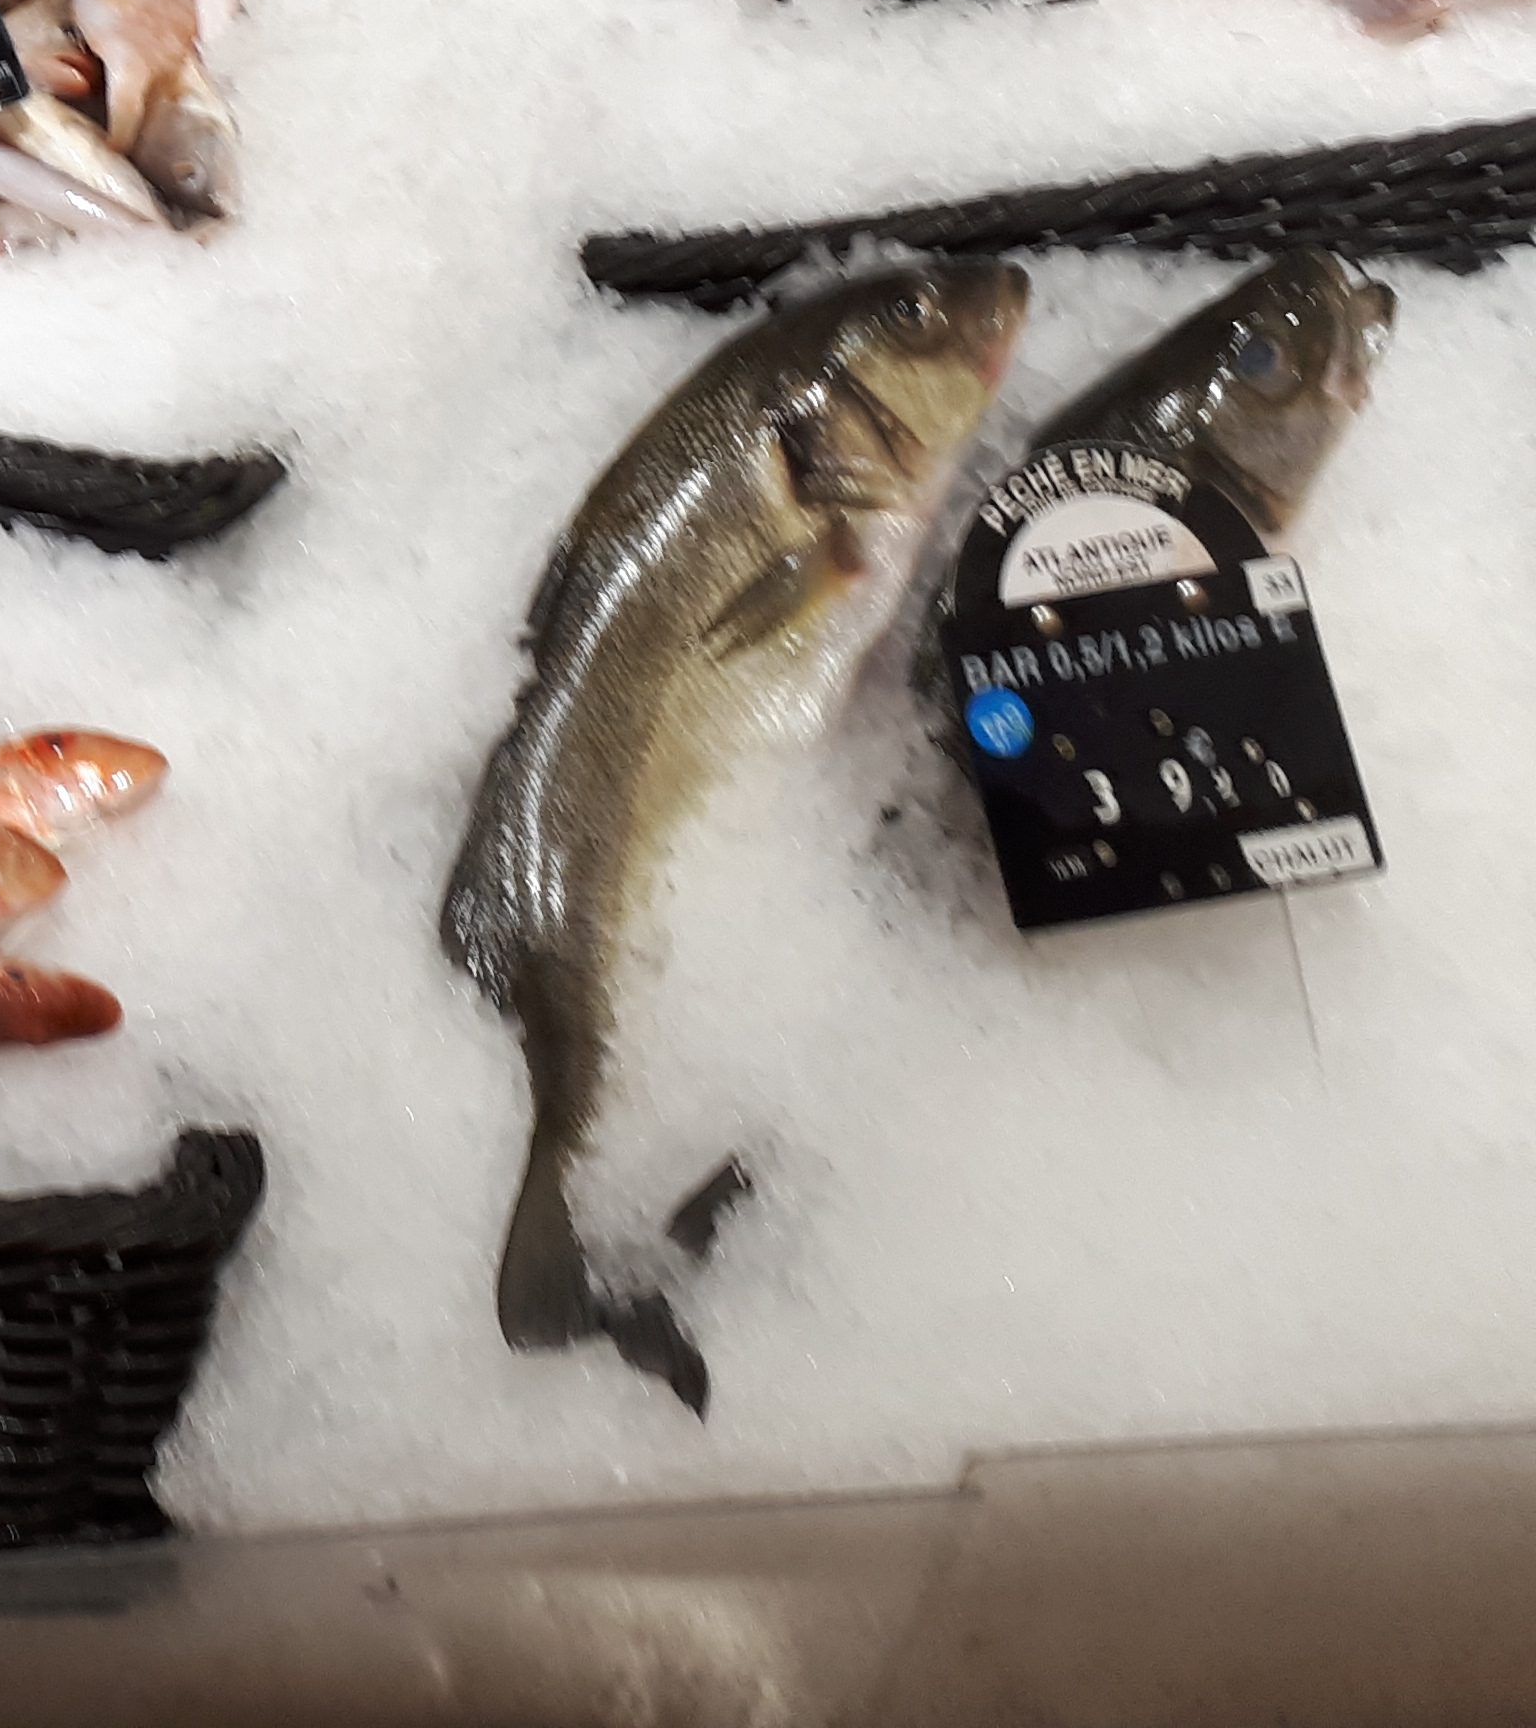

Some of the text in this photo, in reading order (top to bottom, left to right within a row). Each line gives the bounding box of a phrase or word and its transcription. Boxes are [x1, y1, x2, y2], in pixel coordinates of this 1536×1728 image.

[1070, 448, 1115, 479] EN
[1023, 523, 1173, 575] ATLANTIQUE
[960, 645, 1044, 692] BAR
